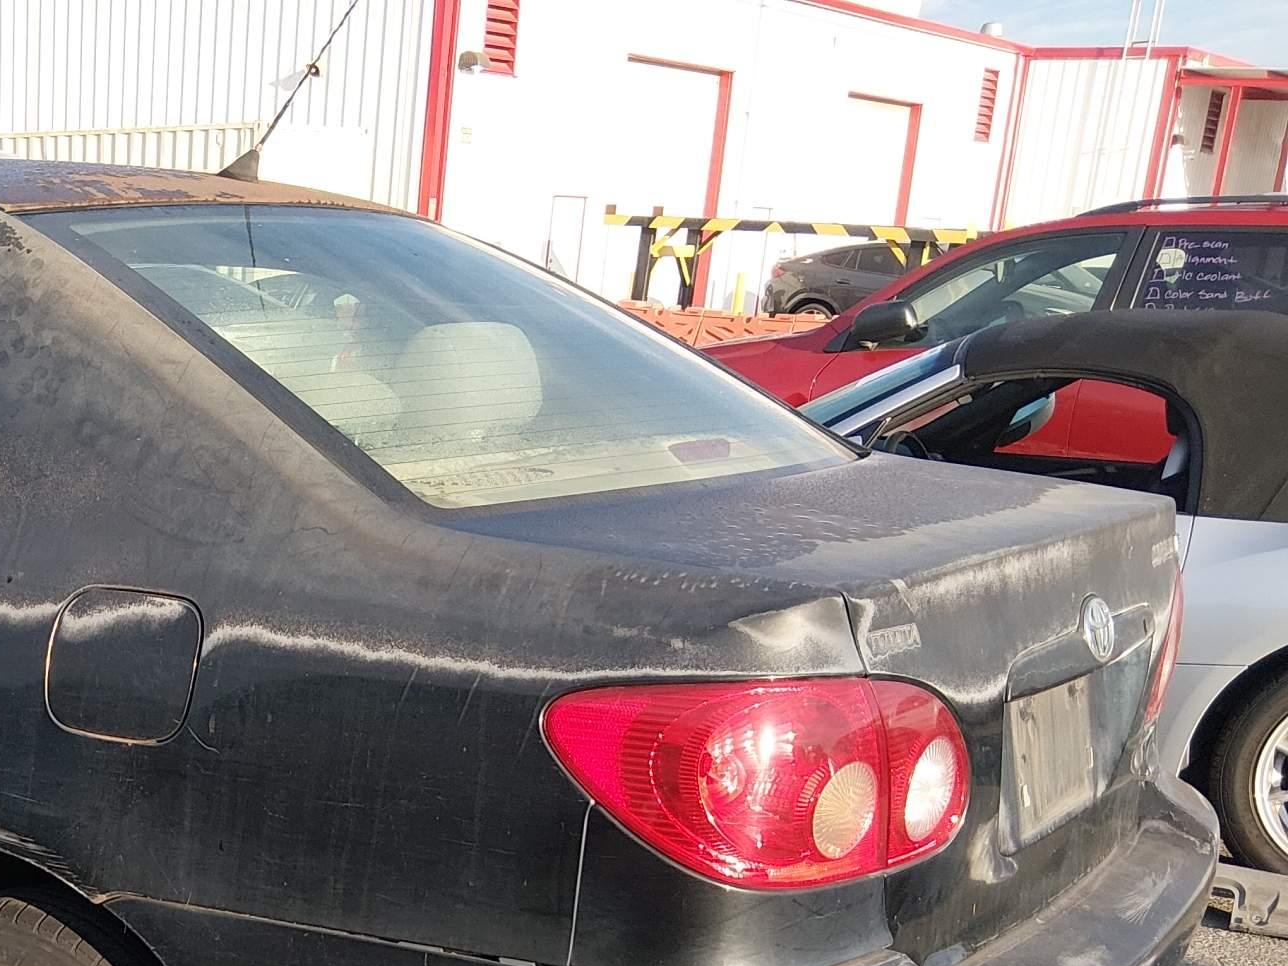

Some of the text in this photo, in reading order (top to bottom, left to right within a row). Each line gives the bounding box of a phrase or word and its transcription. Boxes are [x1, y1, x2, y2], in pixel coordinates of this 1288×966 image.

[1196, 270, 1242, 282] Coolant
[1164, 289, 1193, 299] Color
[1198, 289, 1228, 299] Sand
